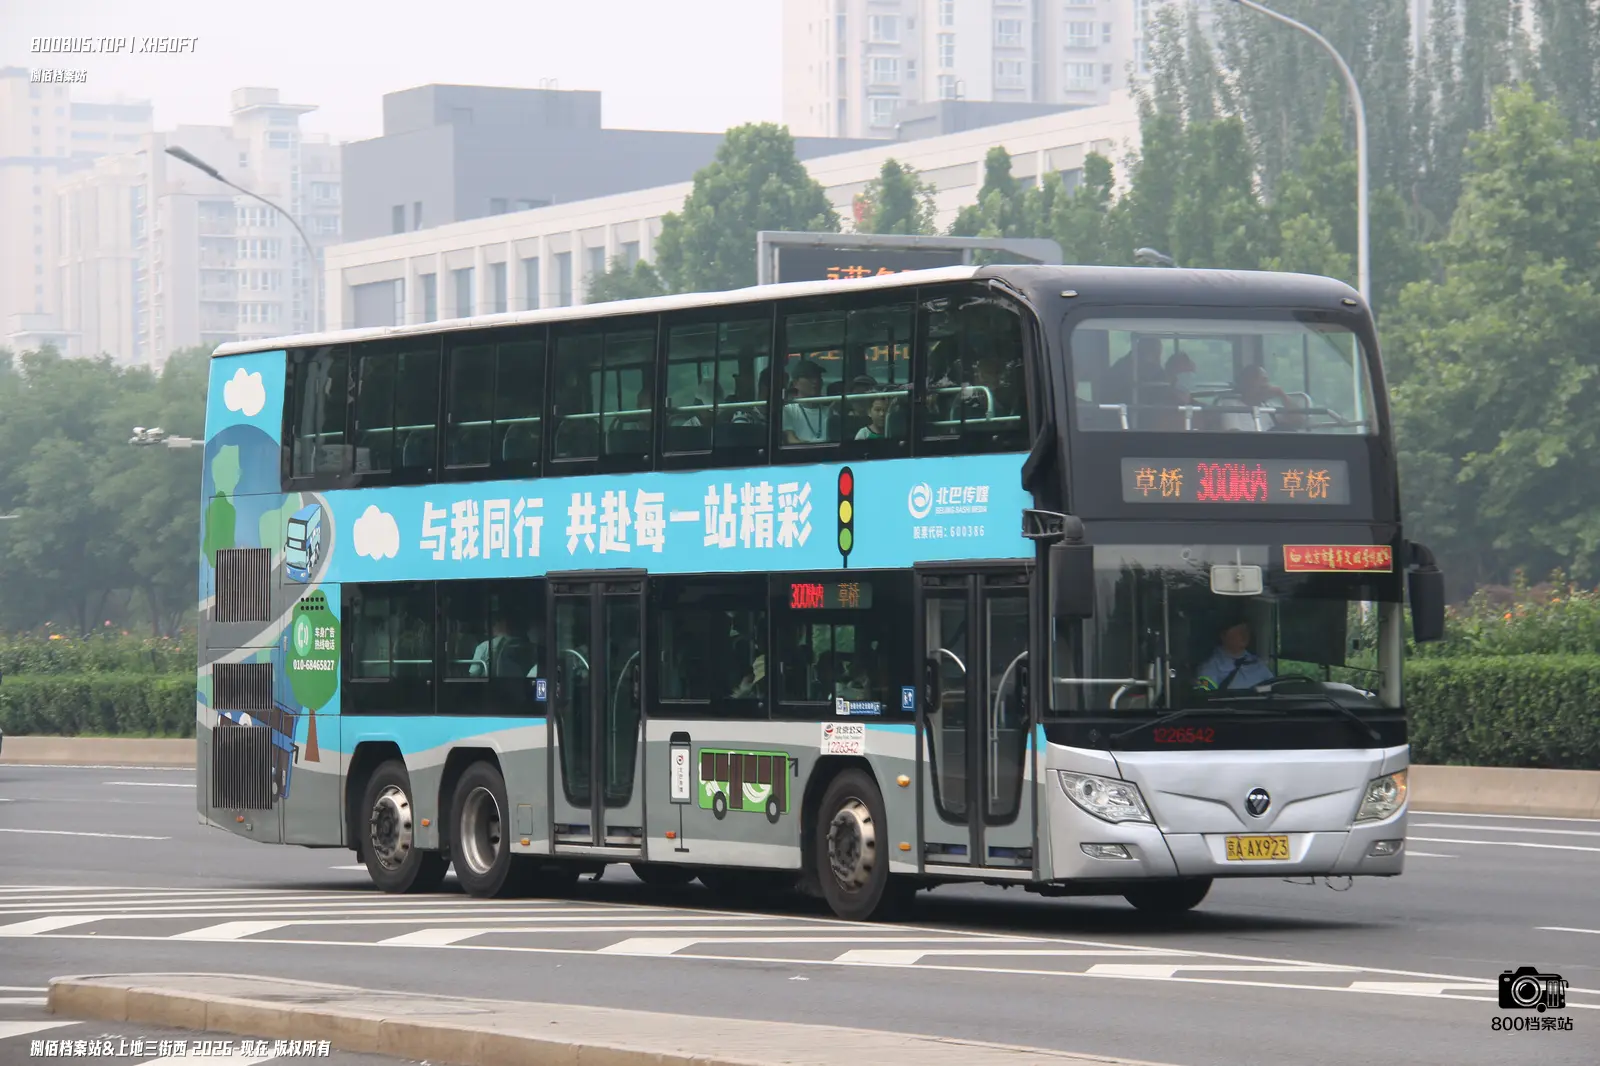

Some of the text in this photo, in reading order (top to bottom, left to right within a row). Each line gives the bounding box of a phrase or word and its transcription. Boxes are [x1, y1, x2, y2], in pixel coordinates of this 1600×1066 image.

[1134, 467, 1183, 497] 草桥
[1280, 469, 1331, 499] 草桥
[935, 486, 989, 504] 北巴传媒
[419, 481, 812, 561] 与我同行 共赴每一站精彩
[838, 582, 860, 609] 草桥
[314, 627, 335, 638] 车身广告
[314, 639, 335, 650] 热线电话
[292, 659, 335, 671] 010-68465827
[1153, 727, 1215, 743] 1226542
[827, 741, 859, 754] 1226542
